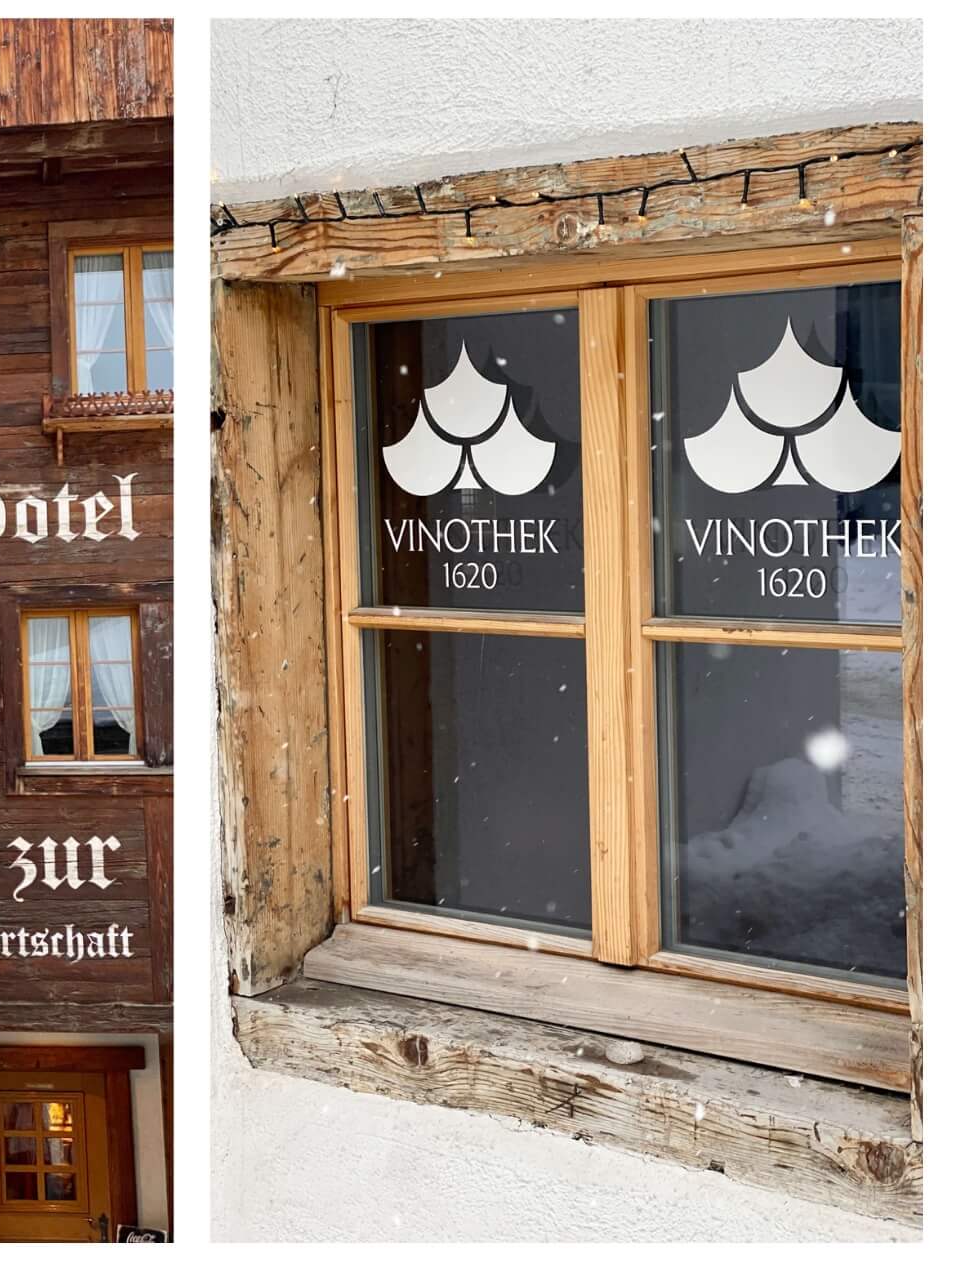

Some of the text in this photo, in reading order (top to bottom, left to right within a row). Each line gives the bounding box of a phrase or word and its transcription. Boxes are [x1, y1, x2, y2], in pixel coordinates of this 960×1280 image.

[384, 517, 559, 554] VINOTHEK
[685, 518, 902, 558] VINOTHEK
[443, 561, 498, 590] 1620
[758, 567, 826, 598] 1620
[6, 835, 122, 903] zur
